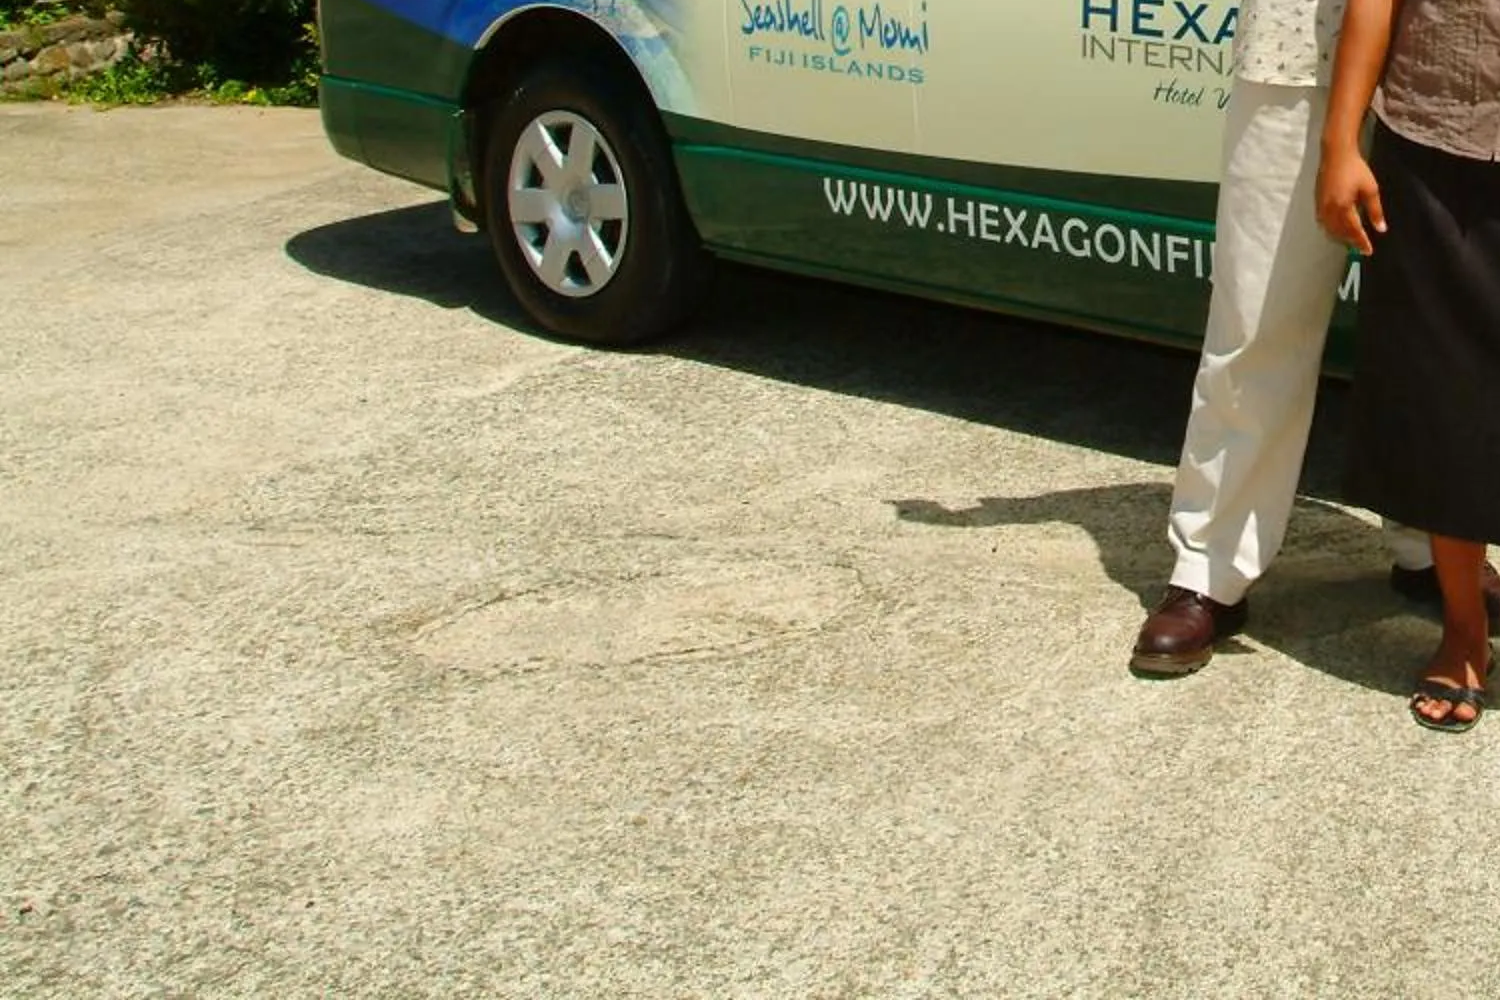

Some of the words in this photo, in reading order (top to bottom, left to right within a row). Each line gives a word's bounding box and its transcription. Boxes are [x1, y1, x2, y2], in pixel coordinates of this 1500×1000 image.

[832, 5, 853, 57] @
[858, 0, 930, 54] Momi
[749, 46, 794, 66] FIJI
[802, 53, 925, 84] ISLANDS
[1081, 33, 1236, 77] INTERN
[1153, 77, 1204, 106] Hotel
